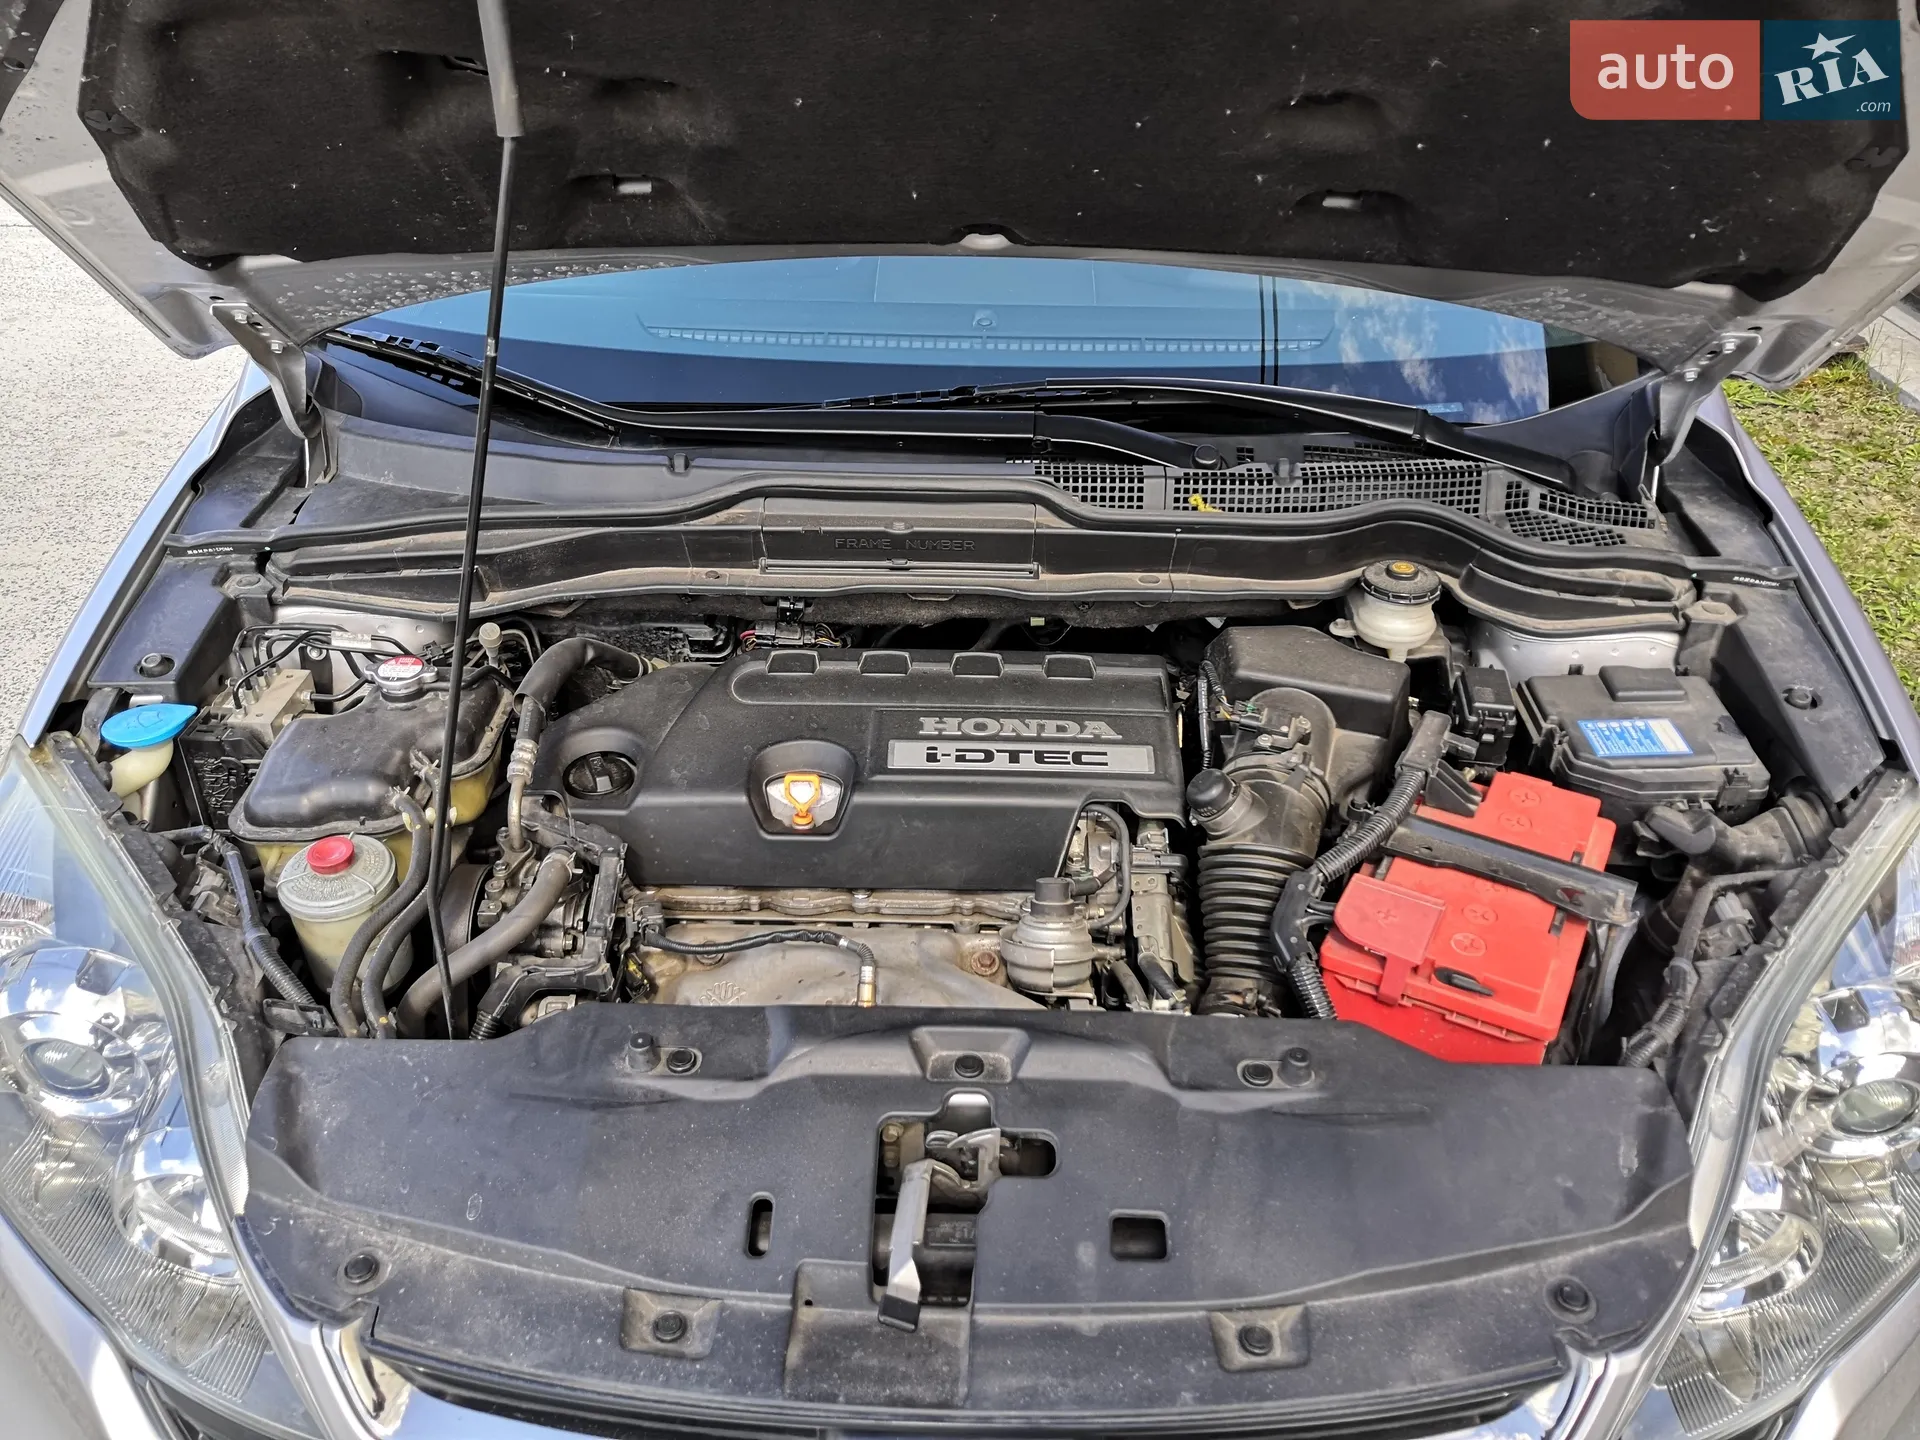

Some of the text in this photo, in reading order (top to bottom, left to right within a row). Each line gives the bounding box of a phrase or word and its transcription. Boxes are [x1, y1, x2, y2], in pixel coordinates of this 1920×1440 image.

[834, 538, 976, 551] FRAME NUMBER
[919, 716, 1123, 740] HONDA
[925, 745, 1109, 767] i-DTEC
